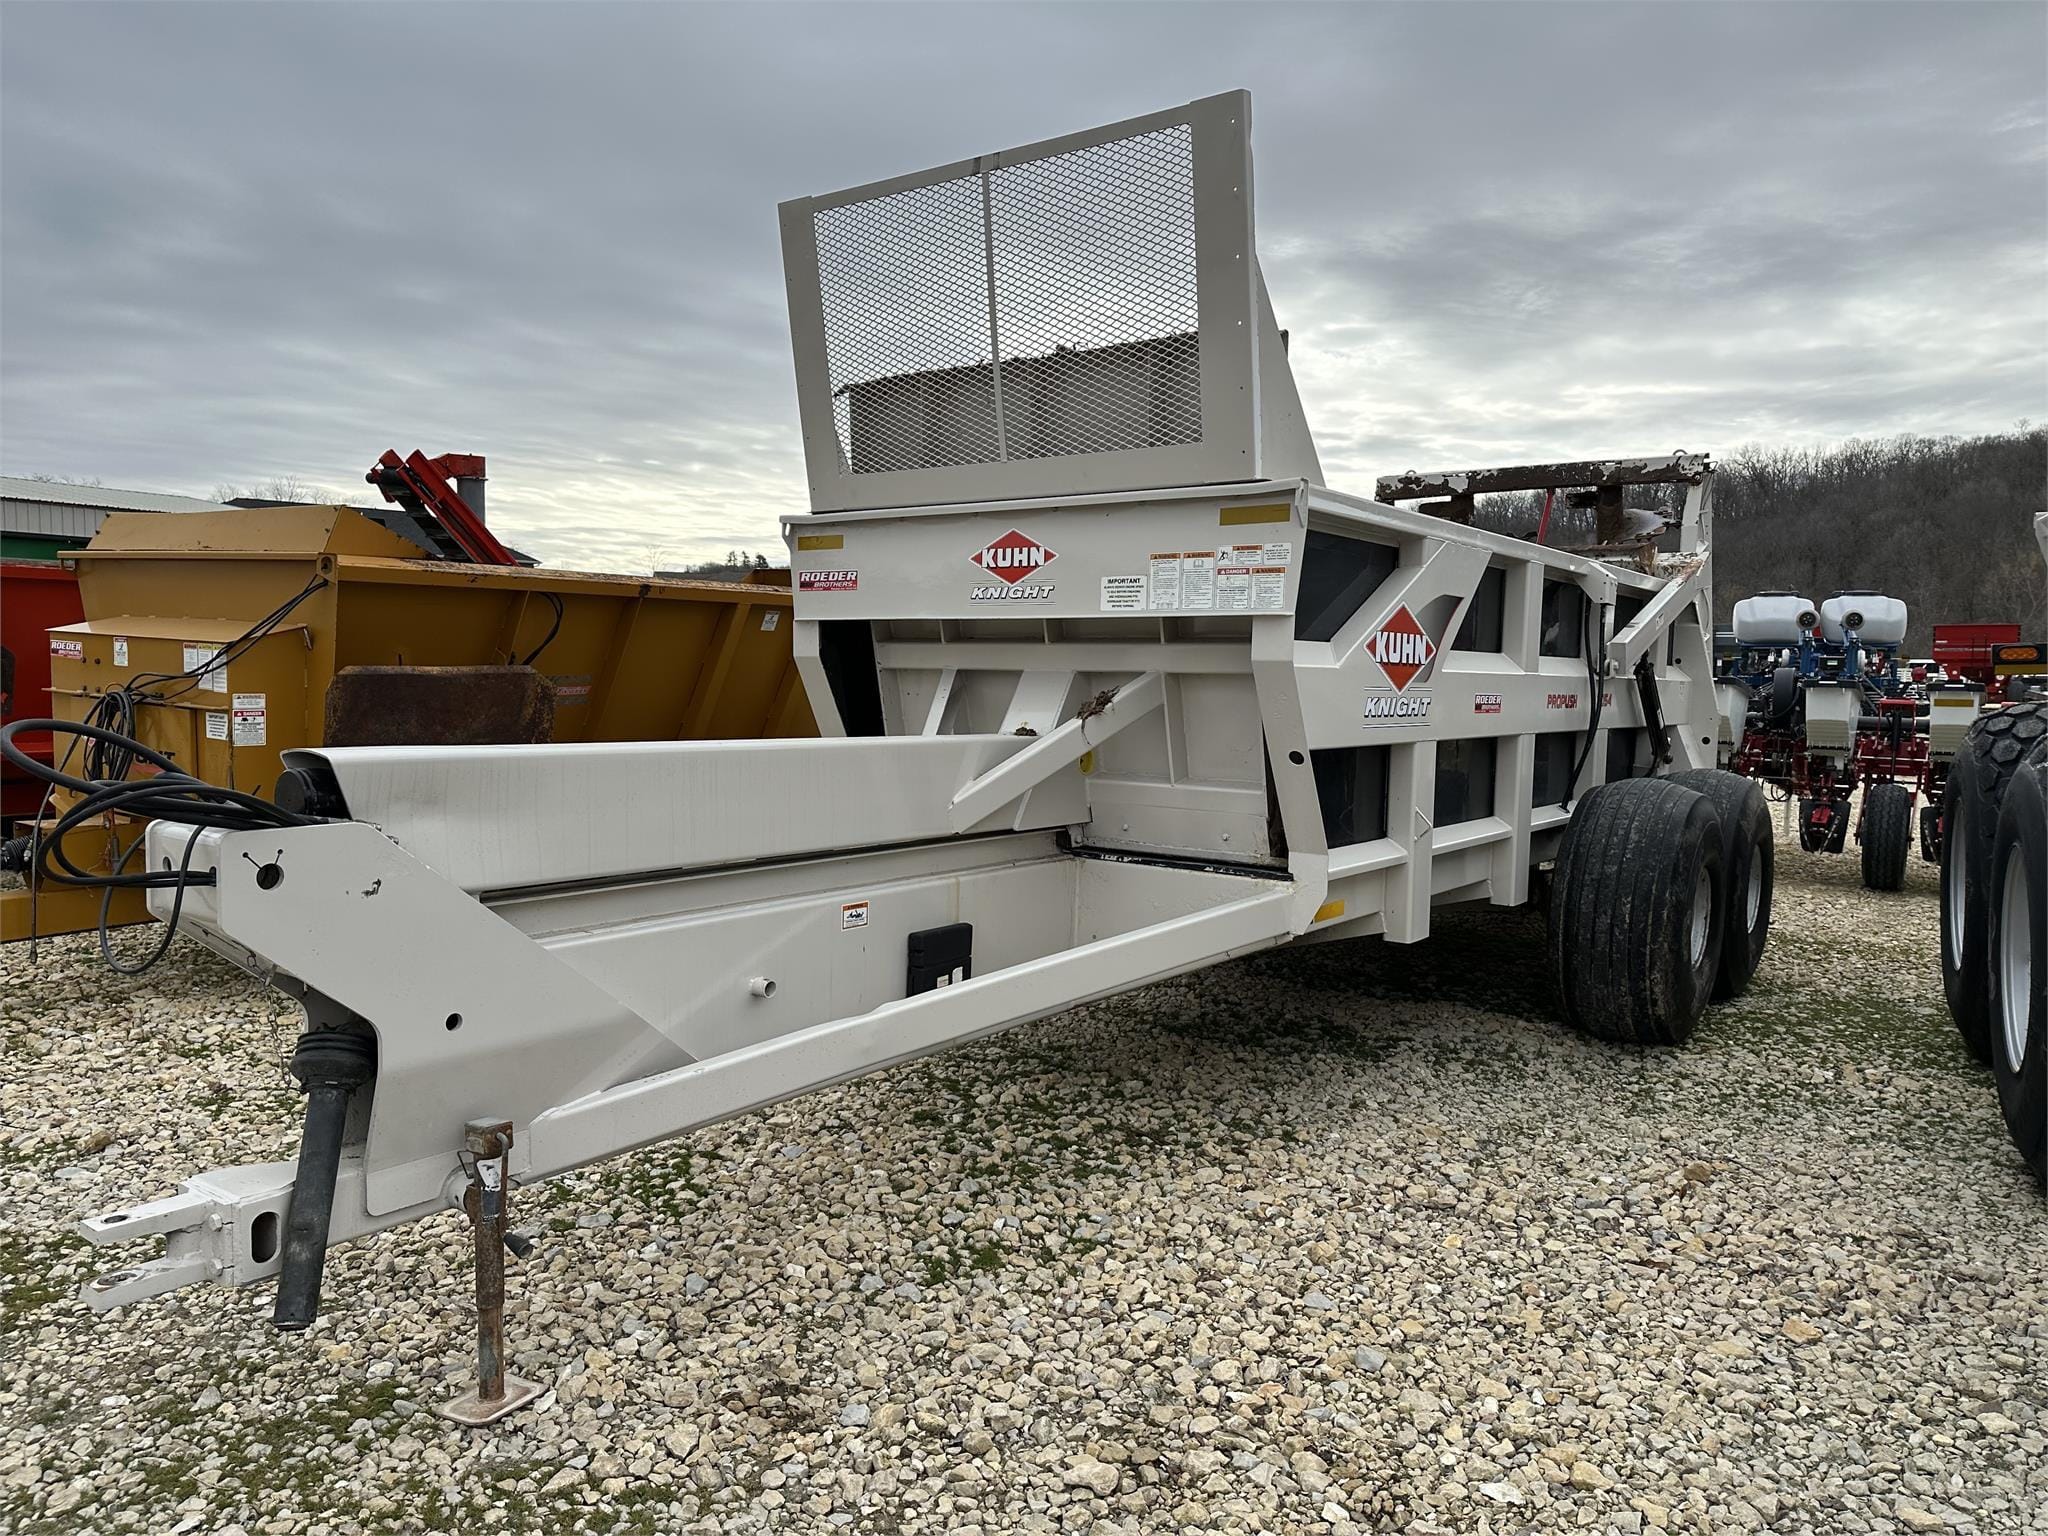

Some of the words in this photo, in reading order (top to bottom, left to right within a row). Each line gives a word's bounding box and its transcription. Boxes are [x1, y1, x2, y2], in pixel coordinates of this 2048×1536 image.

[981, 546, 1045, 569] KUHN
[800, 571, 857, 581] ROEDER
[970, 585, 1056, 600] KNIGHT
[50, 641, 81, 651] ROEDER
[1375, 630, 1428, 666] KUHN
[1363, 696, 1432, 718] KNIGHT
[1475, 695, 1502, 704] ROEDER
